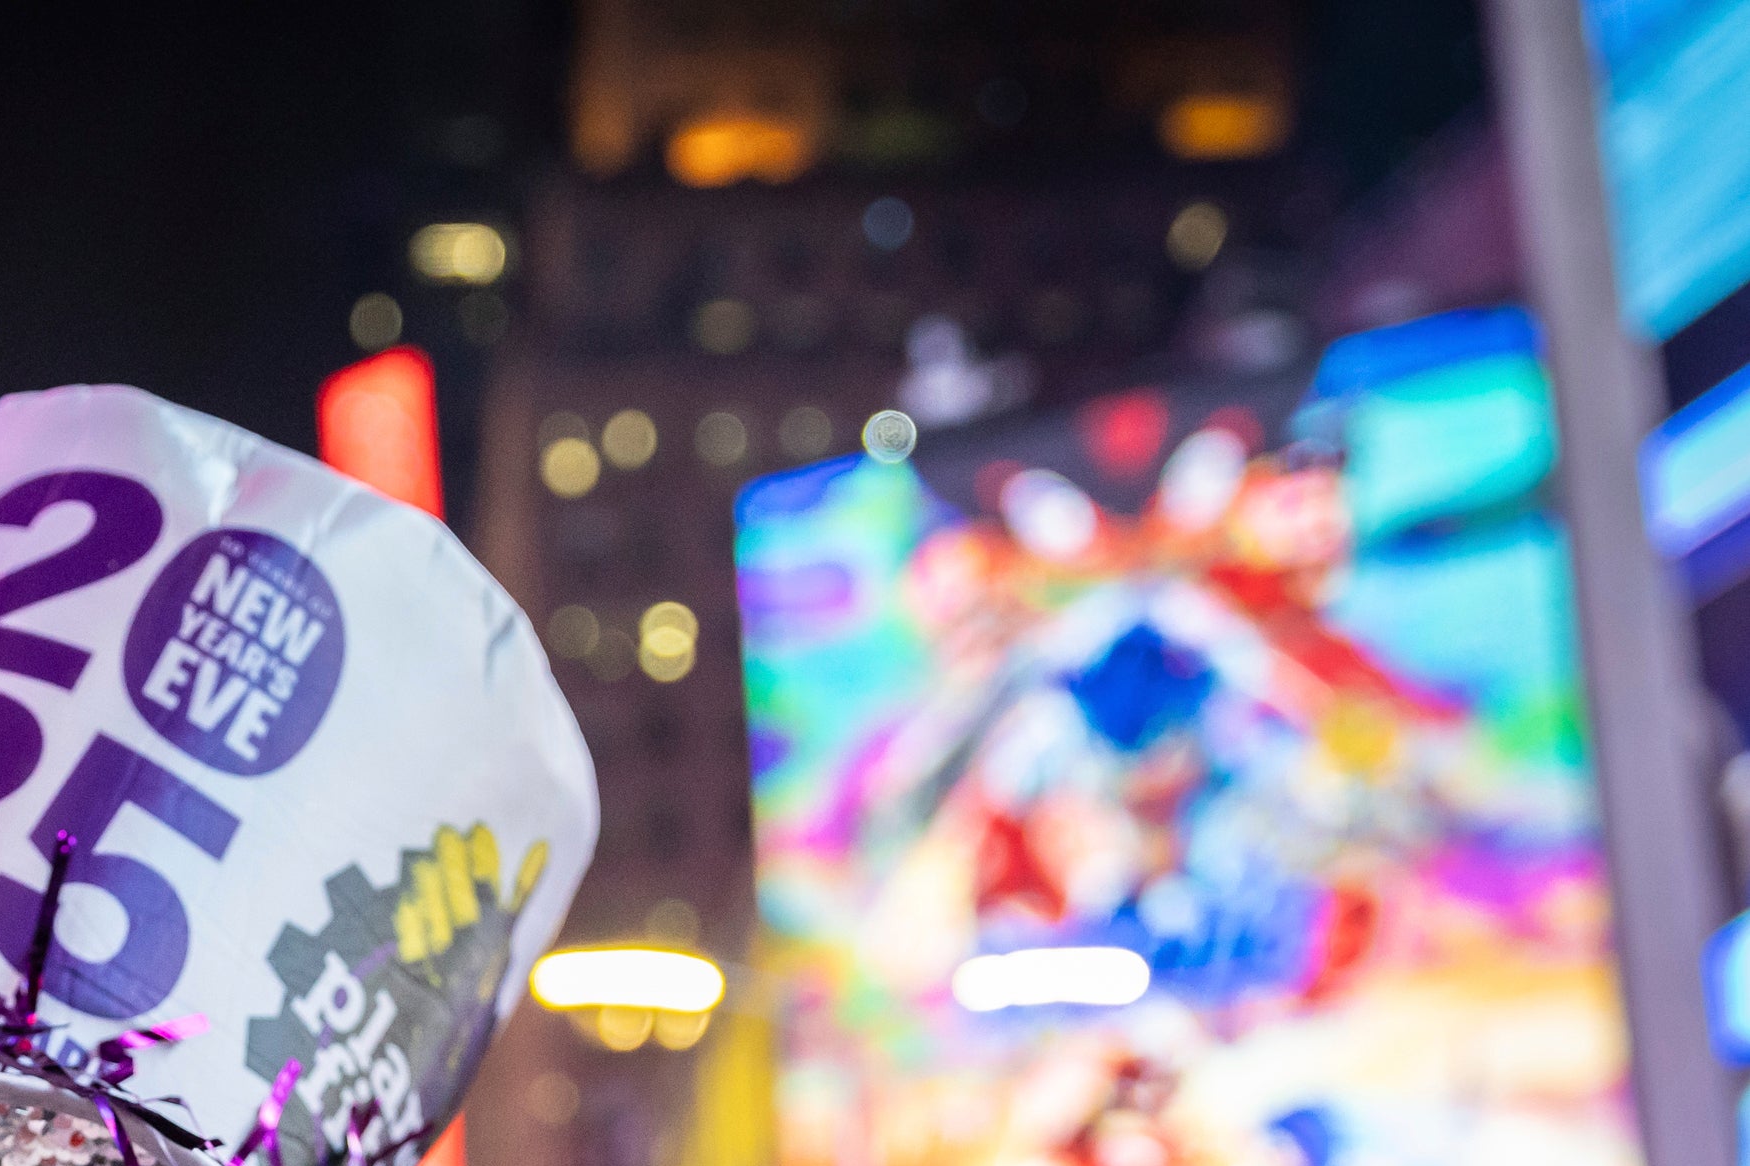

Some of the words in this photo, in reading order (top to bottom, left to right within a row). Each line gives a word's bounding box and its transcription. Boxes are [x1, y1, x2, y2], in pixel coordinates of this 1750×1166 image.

[177, 602, 298, 700] YEAR'S
[189, 552, 325, 667] NEW
[142, 635, 284, 763] EVE
